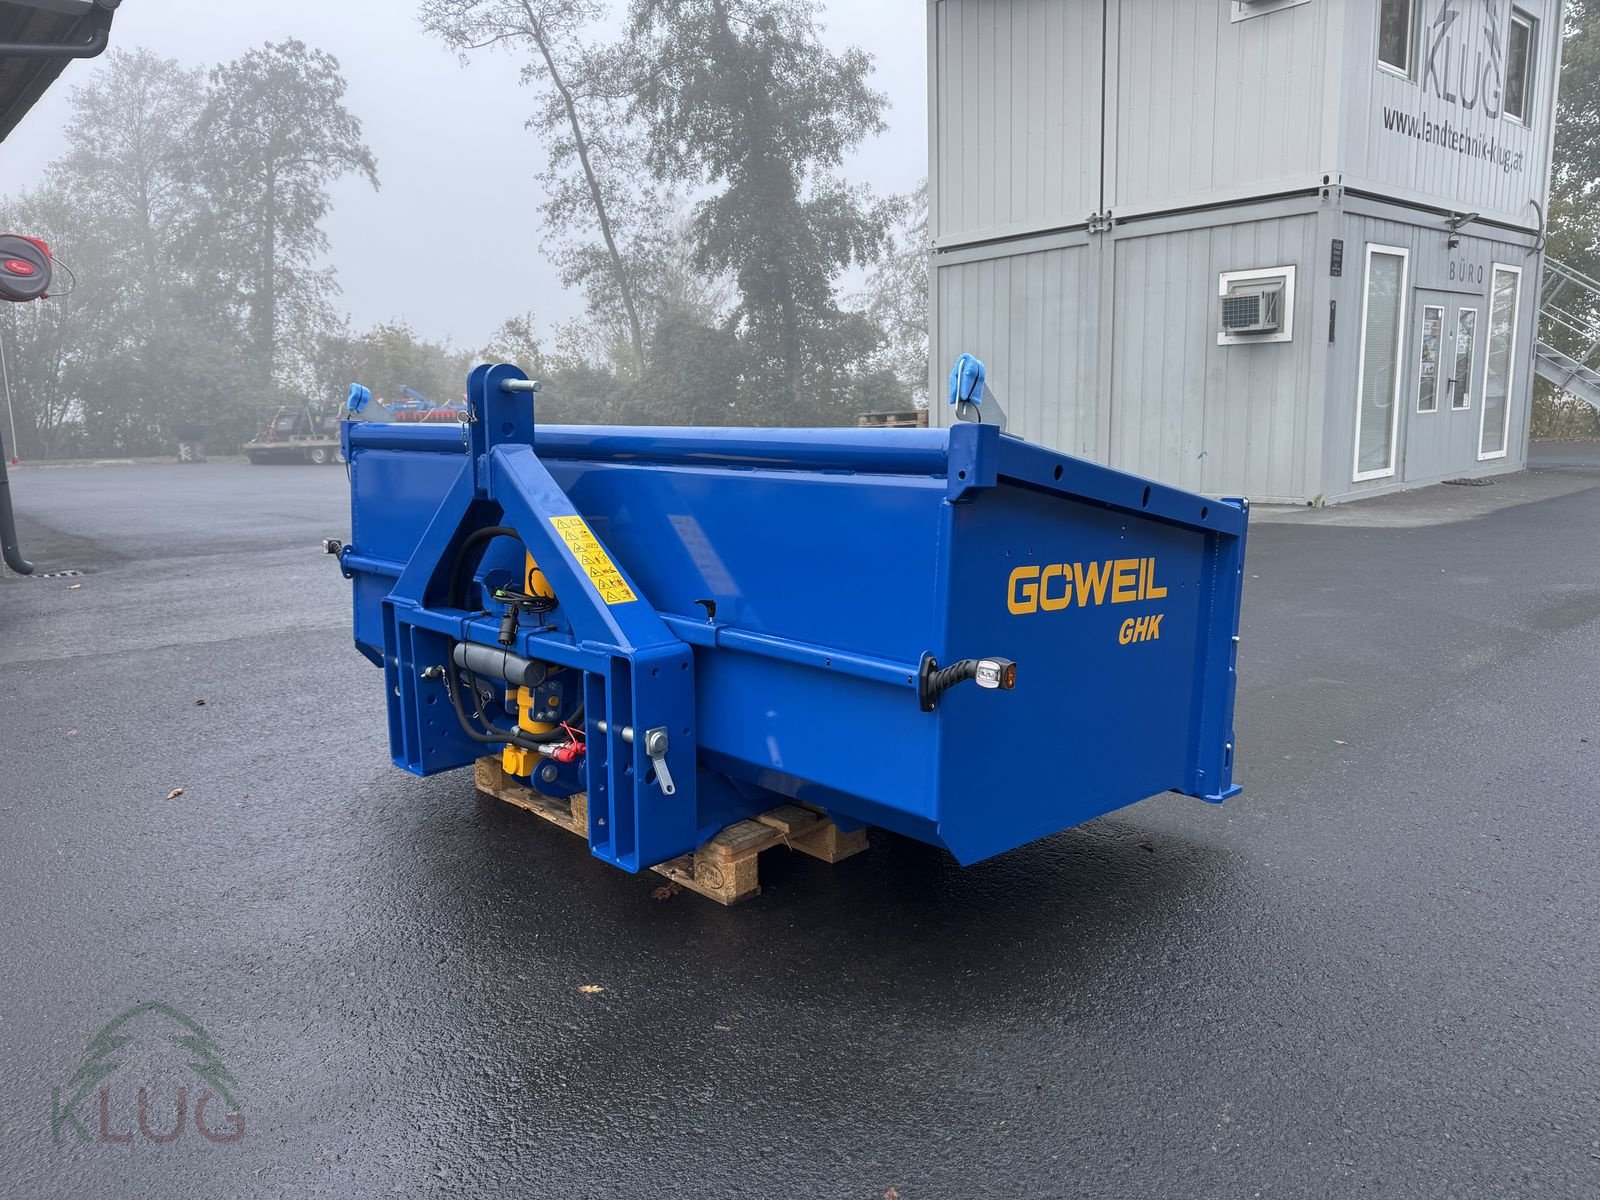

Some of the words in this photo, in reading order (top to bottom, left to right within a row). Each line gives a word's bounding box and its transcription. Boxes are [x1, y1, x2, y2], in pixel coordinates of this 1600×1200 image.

[1423, 22, 1502, 119] KLUG
[1384, 106, 1523, 173] www.landtechnik-klug.at
[1450, 258, 1484, 284] BÜRO
[1118, 614, 1164, 645] GHK
